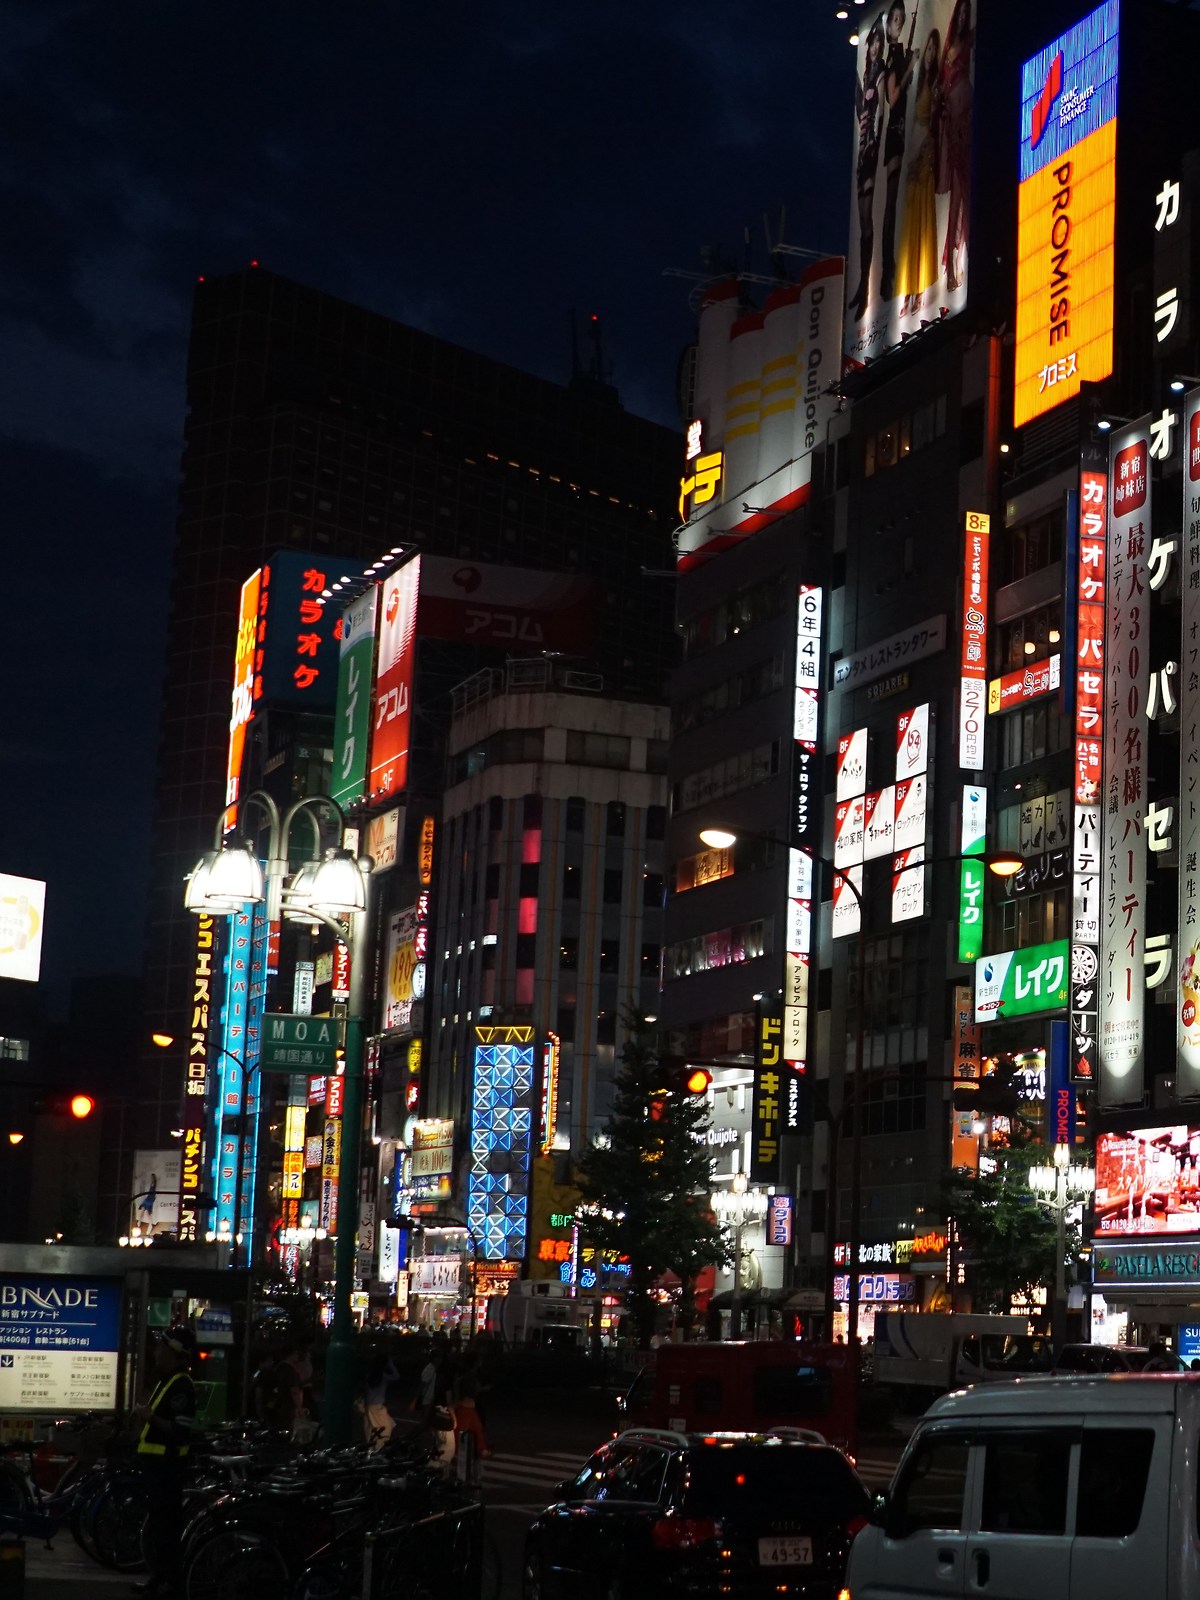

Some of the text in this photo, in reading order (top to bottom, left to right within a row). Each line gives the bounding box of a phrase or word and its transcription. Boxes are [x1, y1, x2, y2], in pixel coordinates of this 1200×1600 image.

[1049, 161, 1072, 347] PROMISE
[804, 286, 825, 449] Don Quijote
[1038, 352, 1078, 393] プロミス
[1119, 455, 1141, 480] 新宿
[1115, 476, 1145, 503] 姉妹店
[969, 514, 987, 530] 8F
[1078, 480, 1105, 730] カラオケ パセラ
[293, 567, 327, 690] カラオケ
[464, 608, 544, 643] アコム
[800, 595, 817, 678] 6年4組
[835, 628, 939, 685] エンタメレストランタワー
[866, 675, 906, 698] SQUARE
[963, 680, 983, 693] 全品
[990, 682, 1001, 704] 8F
[341, 655, 360, 780] レイク
[376, 682, 409, 730] アコム
[899, 717, 909, 732] 9F
[964, 692, 980, 760] 270円均一
[839, 740, 849, 754] 8F
[1088, 742, 1099, 766] 名物
[382, 769, 394, 790] 3F
[866, 797, 876, 811] 5F
[896, 787, 908, 802] 6F
[836, 806, 847, 820] 4F
[896, 809, 925, 831] ロックアップ
[836, 828, 864, 850] 北の家族
[375, 844, 395, 867] アイフル
[894, 858, 905, 872] 2F
[1078, 813, 1096, 913] パーティー
[896, 883, 924, 901] アラビアン
[964, 871, 981, 925] レイク
[902, 899, 920, 912] ロック
[794, 909, 803, 947] 北の家族
[1074, 919, 1097, 930] 貸切
[1074, 931, 1097, 940] PARTY
[964, 950, 975, 959] 4F
[337, 954, 348, 990] アイフル
[1014, 963, 1065, 1001] レイク
[978, 984, 1000, 999] 新生銀行
[1058, 989, 1068, 1000] 4F
[791, 965, 802, 1047] アラビアンロック
[1182, 1007, 1195, 1019] 名物
[959, 1011, 968, 1038] セット
[1074, 987, 1095, 1055] ダーツ
[272, 1048, 327, 1065] 靖国通り
[958, 1040, 976, 1079] 麻雀
[328, 1080, 341, 1108] アコム
[758, 1017, 782, 1165] ドンキホーテ
[787, 1078, 799, 1128] ミステリアス
[707, 1127, 739, 1147] Quijote
[324, 1136, 336, 1165] 金の蔵
[321, 1179, 333, 1230] 東京チカラめし
[834, 1245, 844, 1263] 4F
[858, 1243, 893, 1264] 北の家族
[1115, 1254, 1161, 1276] PASELA
[833, 1276, 843, 1300] 薬
[1, 1309, 60, 1320] 新宿サブナード
[35, 1327, 68, 1336] レストラン
